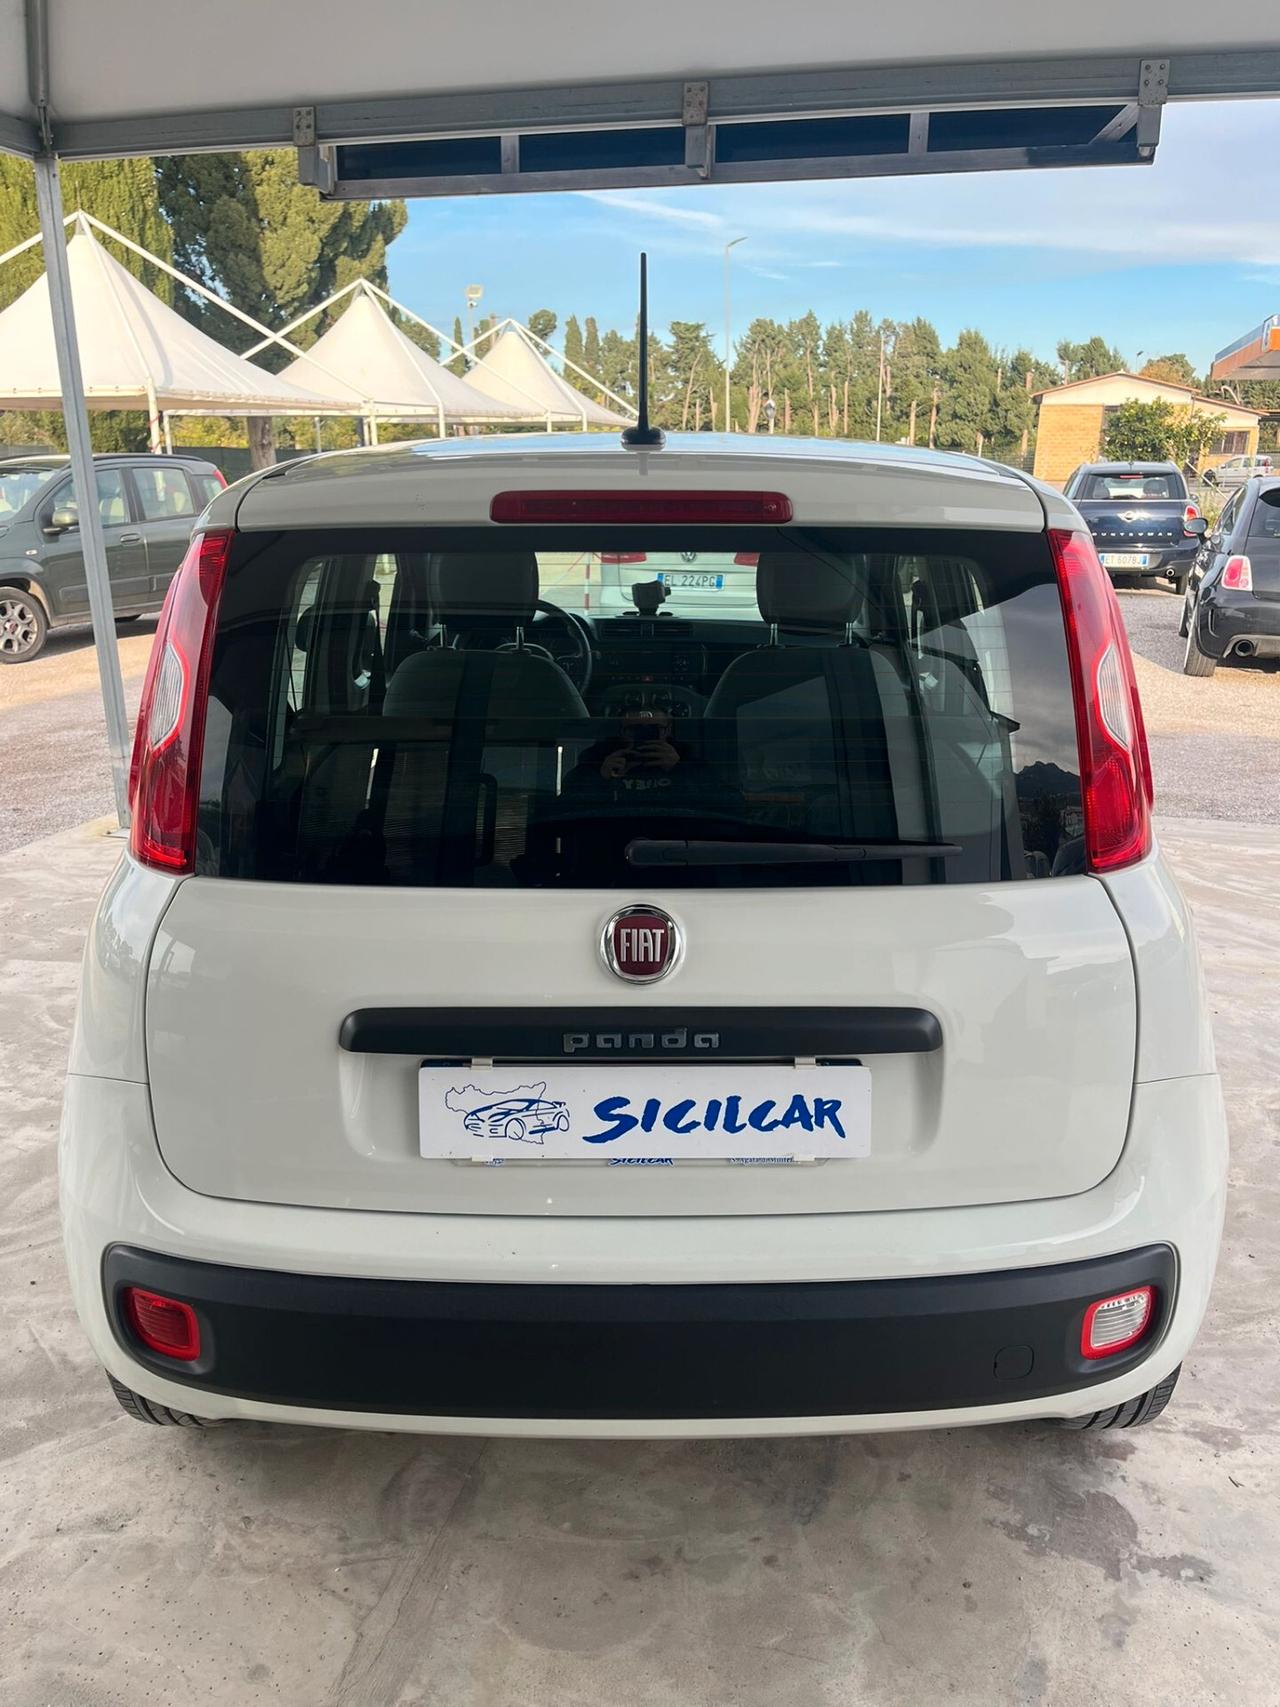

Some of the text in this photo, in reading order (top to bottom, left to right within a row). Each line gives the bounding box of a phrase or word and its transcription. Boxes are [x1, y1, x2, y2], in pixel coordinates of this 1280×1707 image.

[664, 574, 715, 587] EL 224PG
[620, 928, 665, 962] FIAT
[563, 1027, 720, 1053] panda
[582, 1094, 846, 1144] SICILCAR
